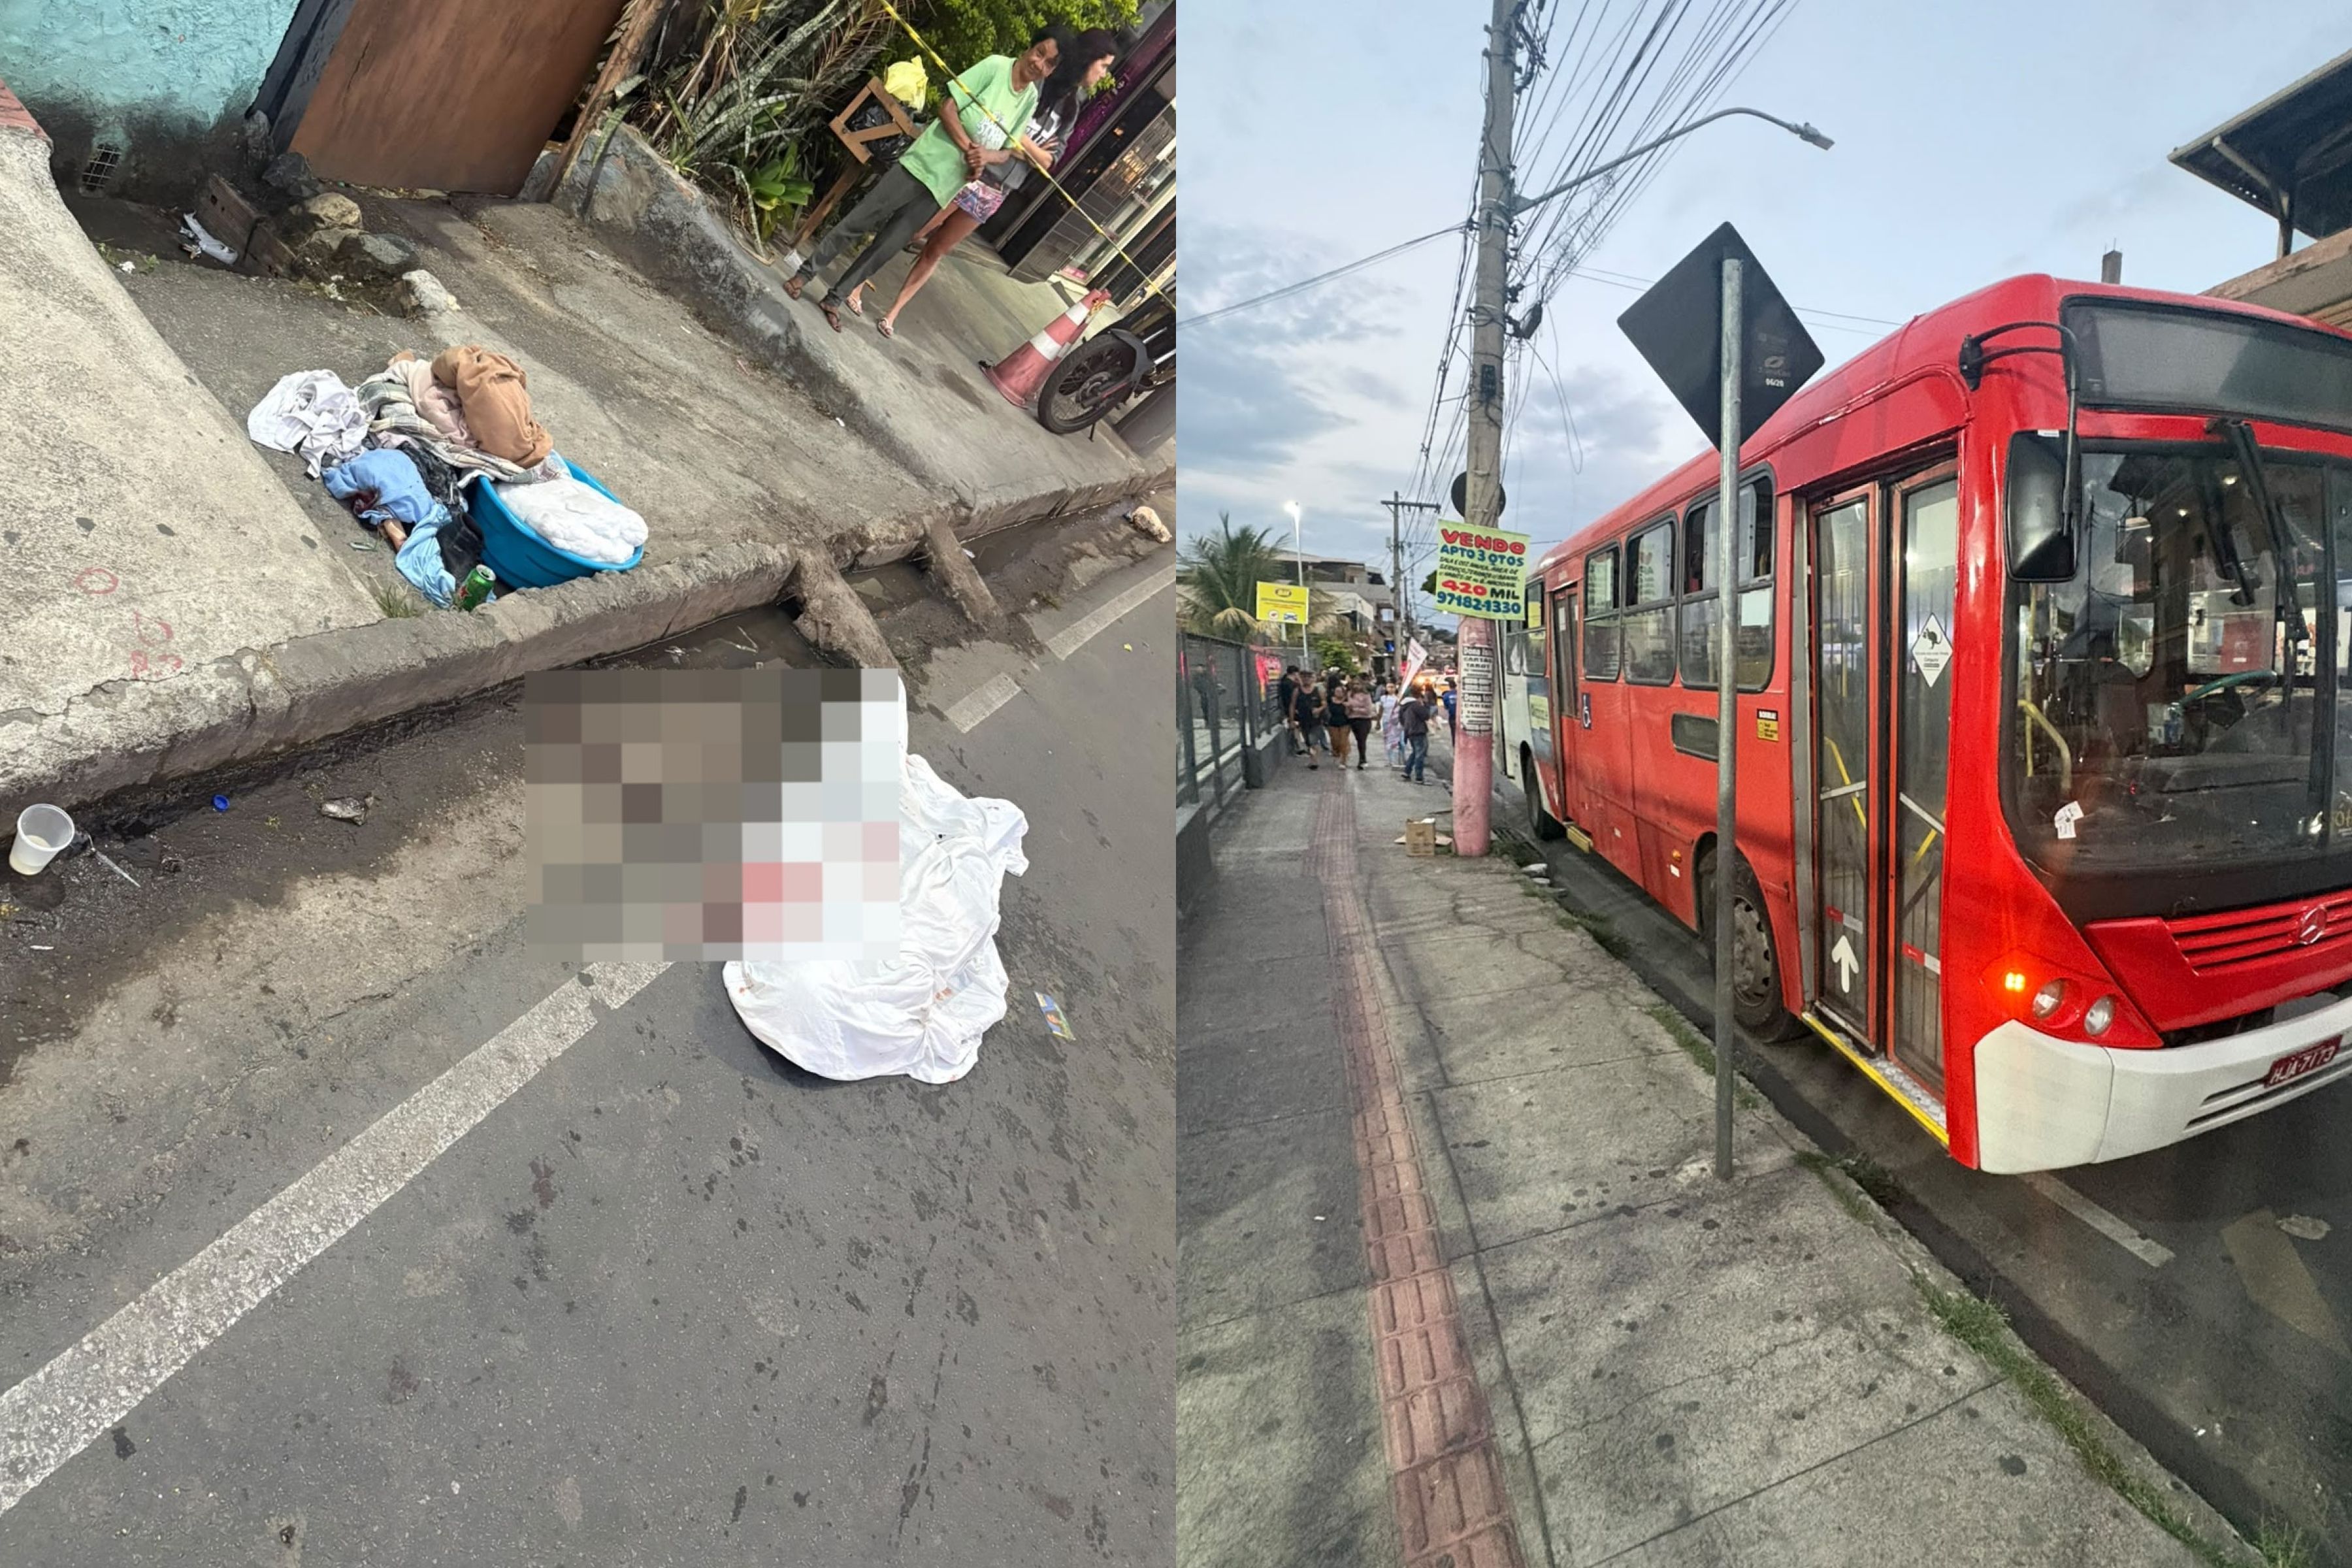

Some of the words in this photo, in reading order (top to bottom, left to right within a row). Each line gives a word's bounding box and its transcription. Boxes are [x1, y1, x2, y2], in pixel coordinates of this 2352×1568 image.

[1441, 528, 1526, 555] VENDO
[1440, 544, 1475, 559] APTO
[1477, 549, 1486, 562] 3
[1488, 553, 1524, 566] QTOS
[1441, 580, 1488, 596] 420
[1490, 587, 1520, 600] MIL
[1437, 591, 1522, 614] 97182-1330
